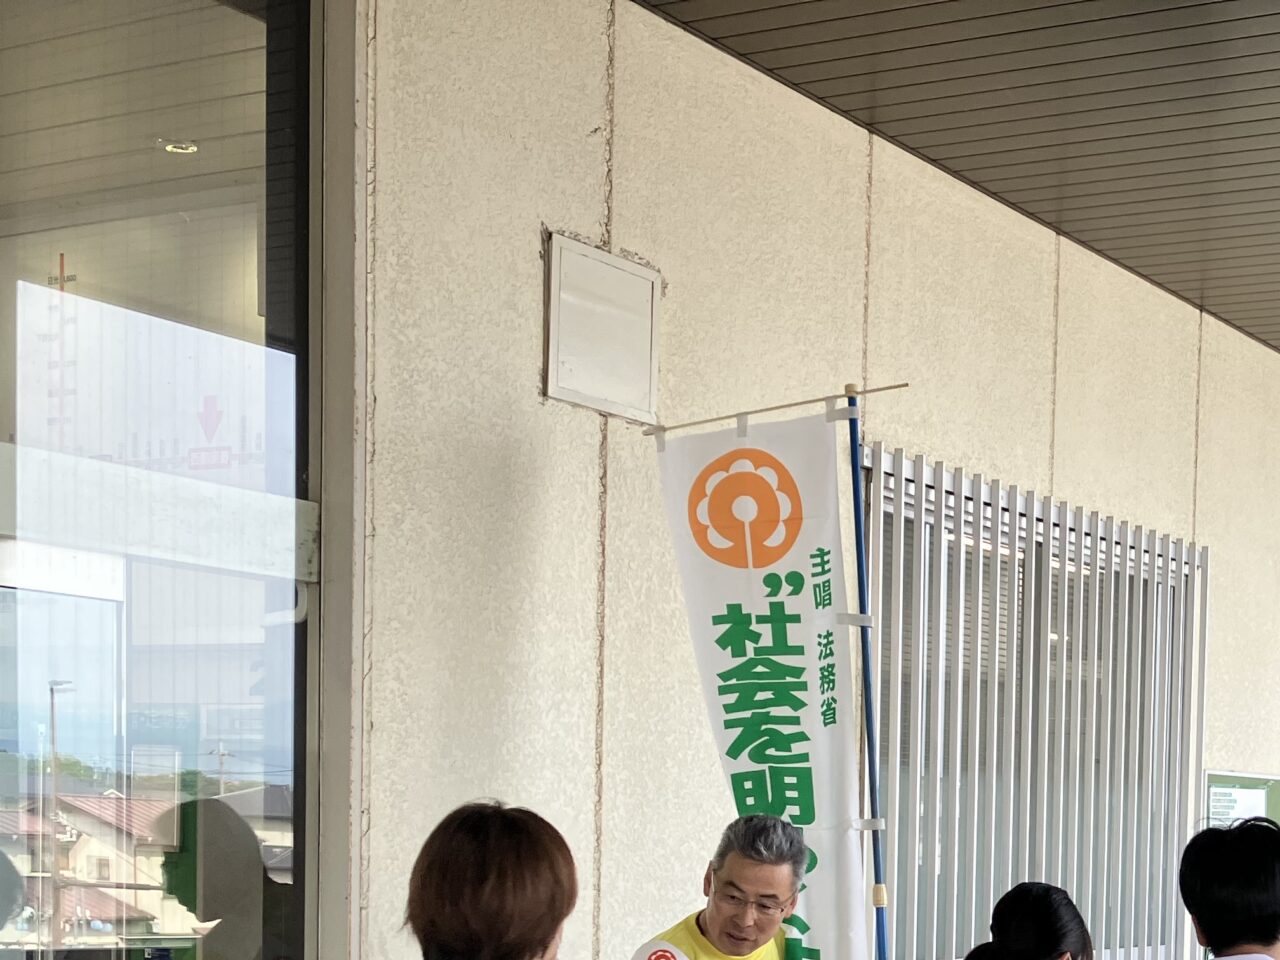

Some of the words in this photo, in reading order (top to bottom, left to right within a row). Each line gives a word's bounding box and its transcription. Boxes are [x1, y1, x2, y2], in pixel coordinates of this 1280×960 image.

[809, 547, 832, 610] 主唱
[816, 629, 838, 728] 法務省
